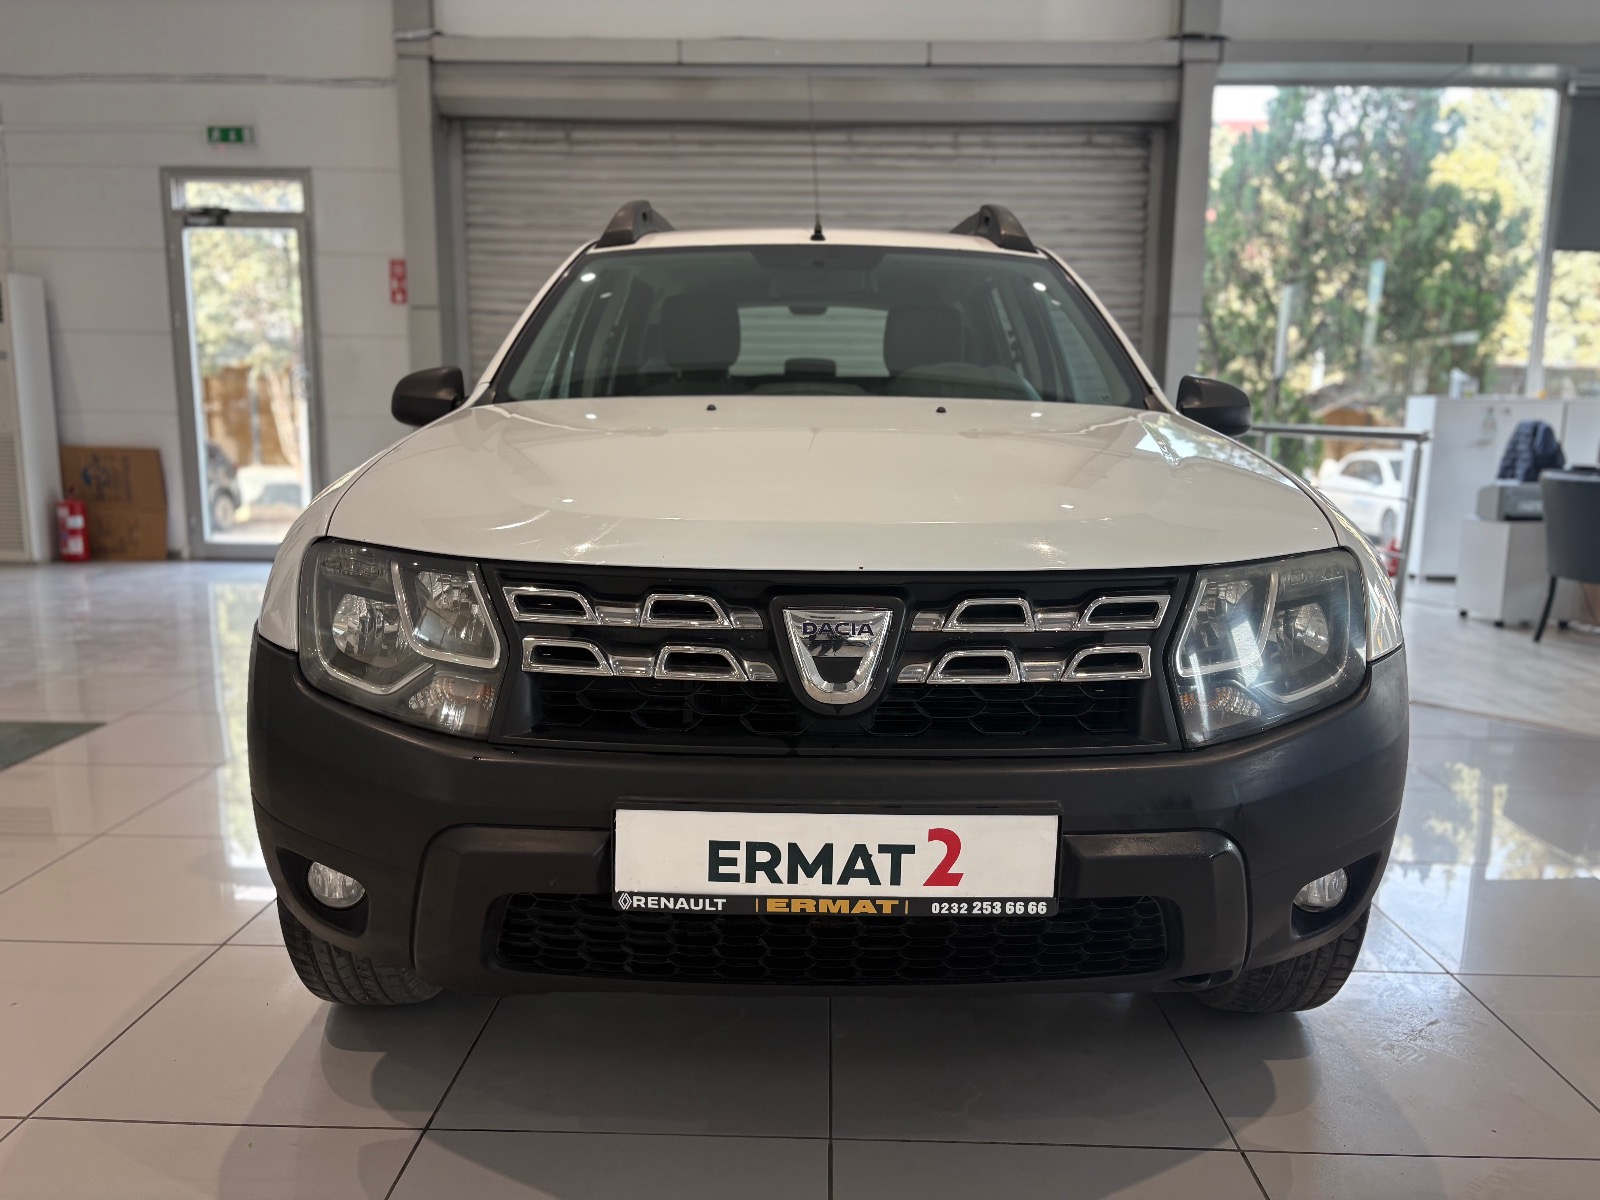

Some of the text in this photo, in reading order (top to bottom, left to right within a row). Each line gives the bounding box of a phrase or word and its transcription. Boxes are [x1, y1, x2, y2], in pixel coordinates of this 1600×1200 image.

[802, 622, 874, 636] DACIA
[707, 827, 965, 887] ERMAT 2
[632, 895, 727, 911] RENAULT
[766, 897, 899, 914] ERMAT
[931, 902, 968, 914] 0232
[972, 901, 1002, 914] 253
